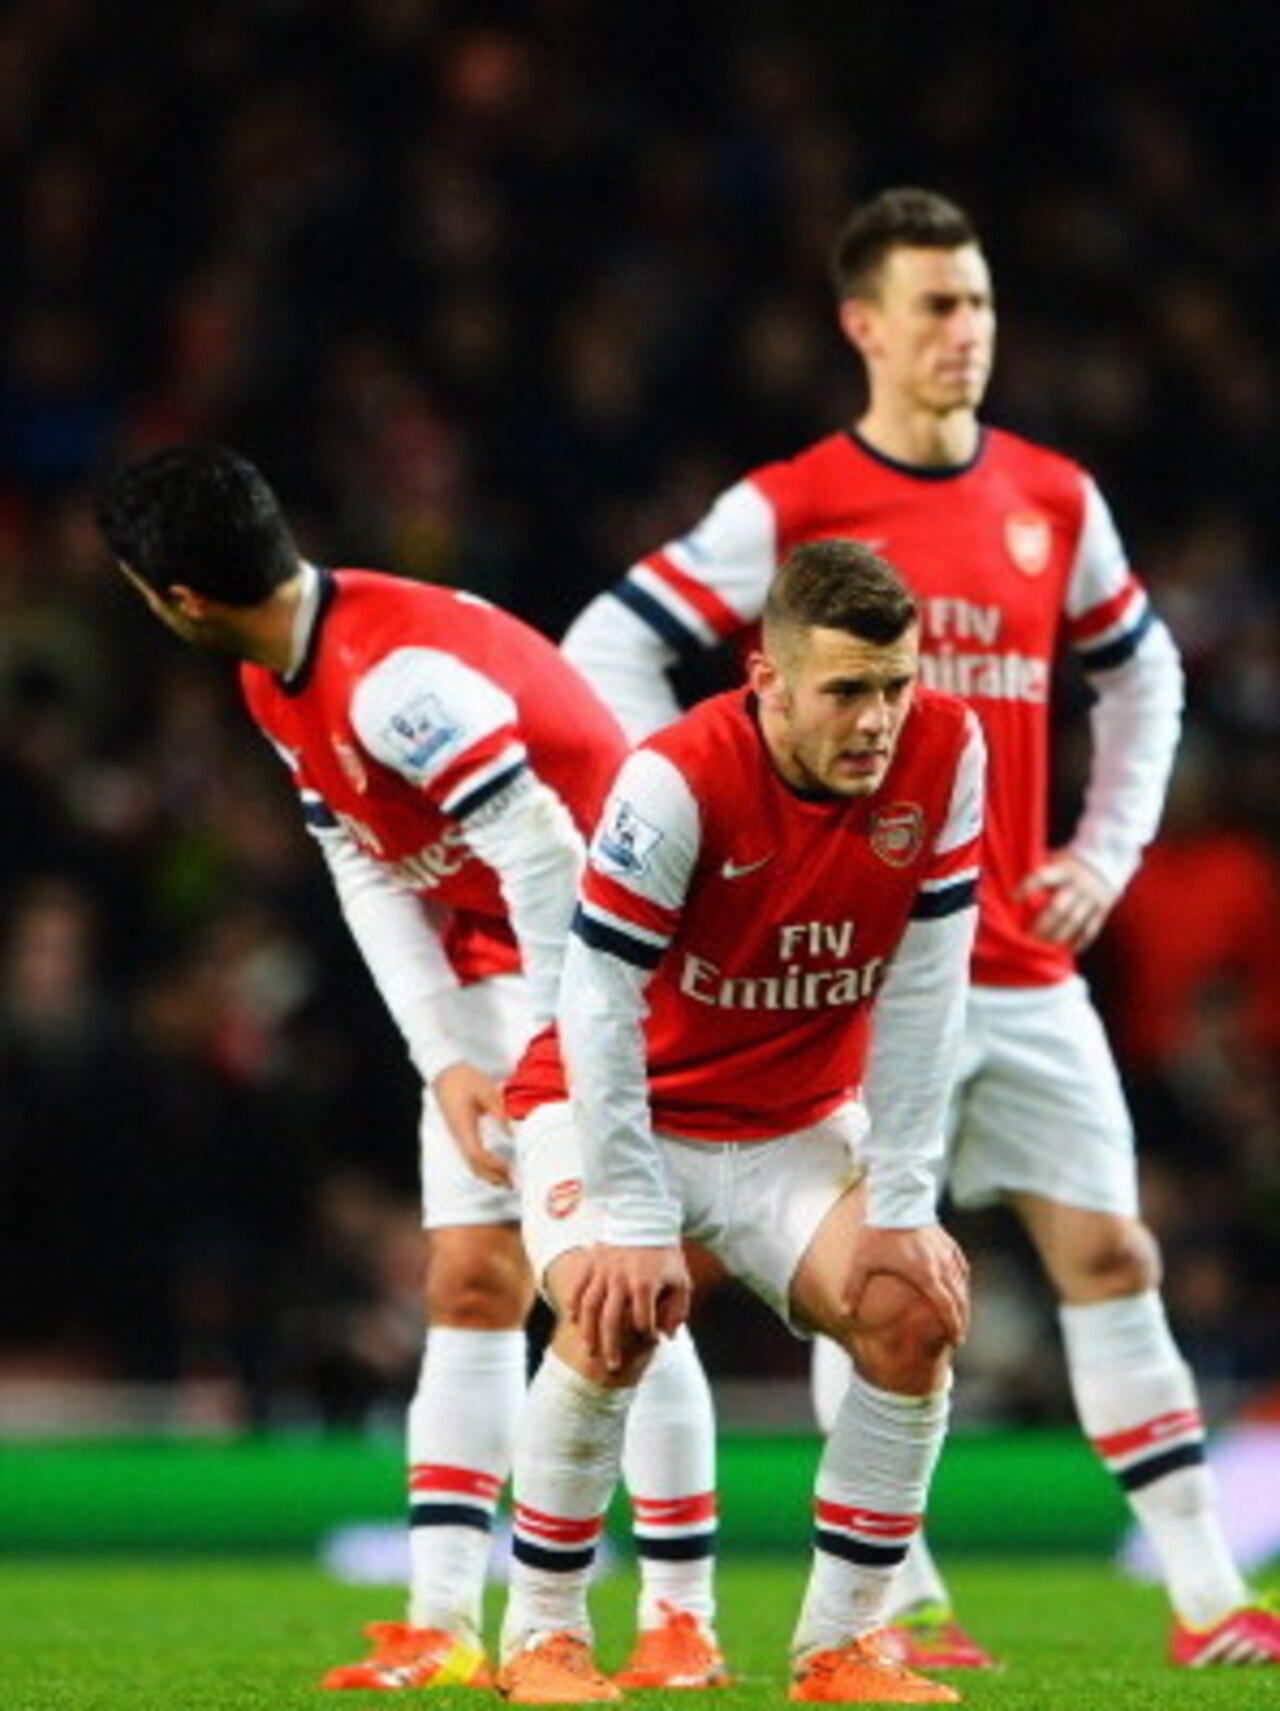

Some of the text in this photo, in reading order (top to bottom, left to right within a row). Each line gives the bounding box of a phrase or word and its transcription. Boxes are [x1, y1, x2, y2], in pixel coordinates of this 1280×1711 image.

[929, 598, 1001, 646] Fly
[778, 921, 855, 960] Fly
[680, 953, 884, 1010] Emirat
